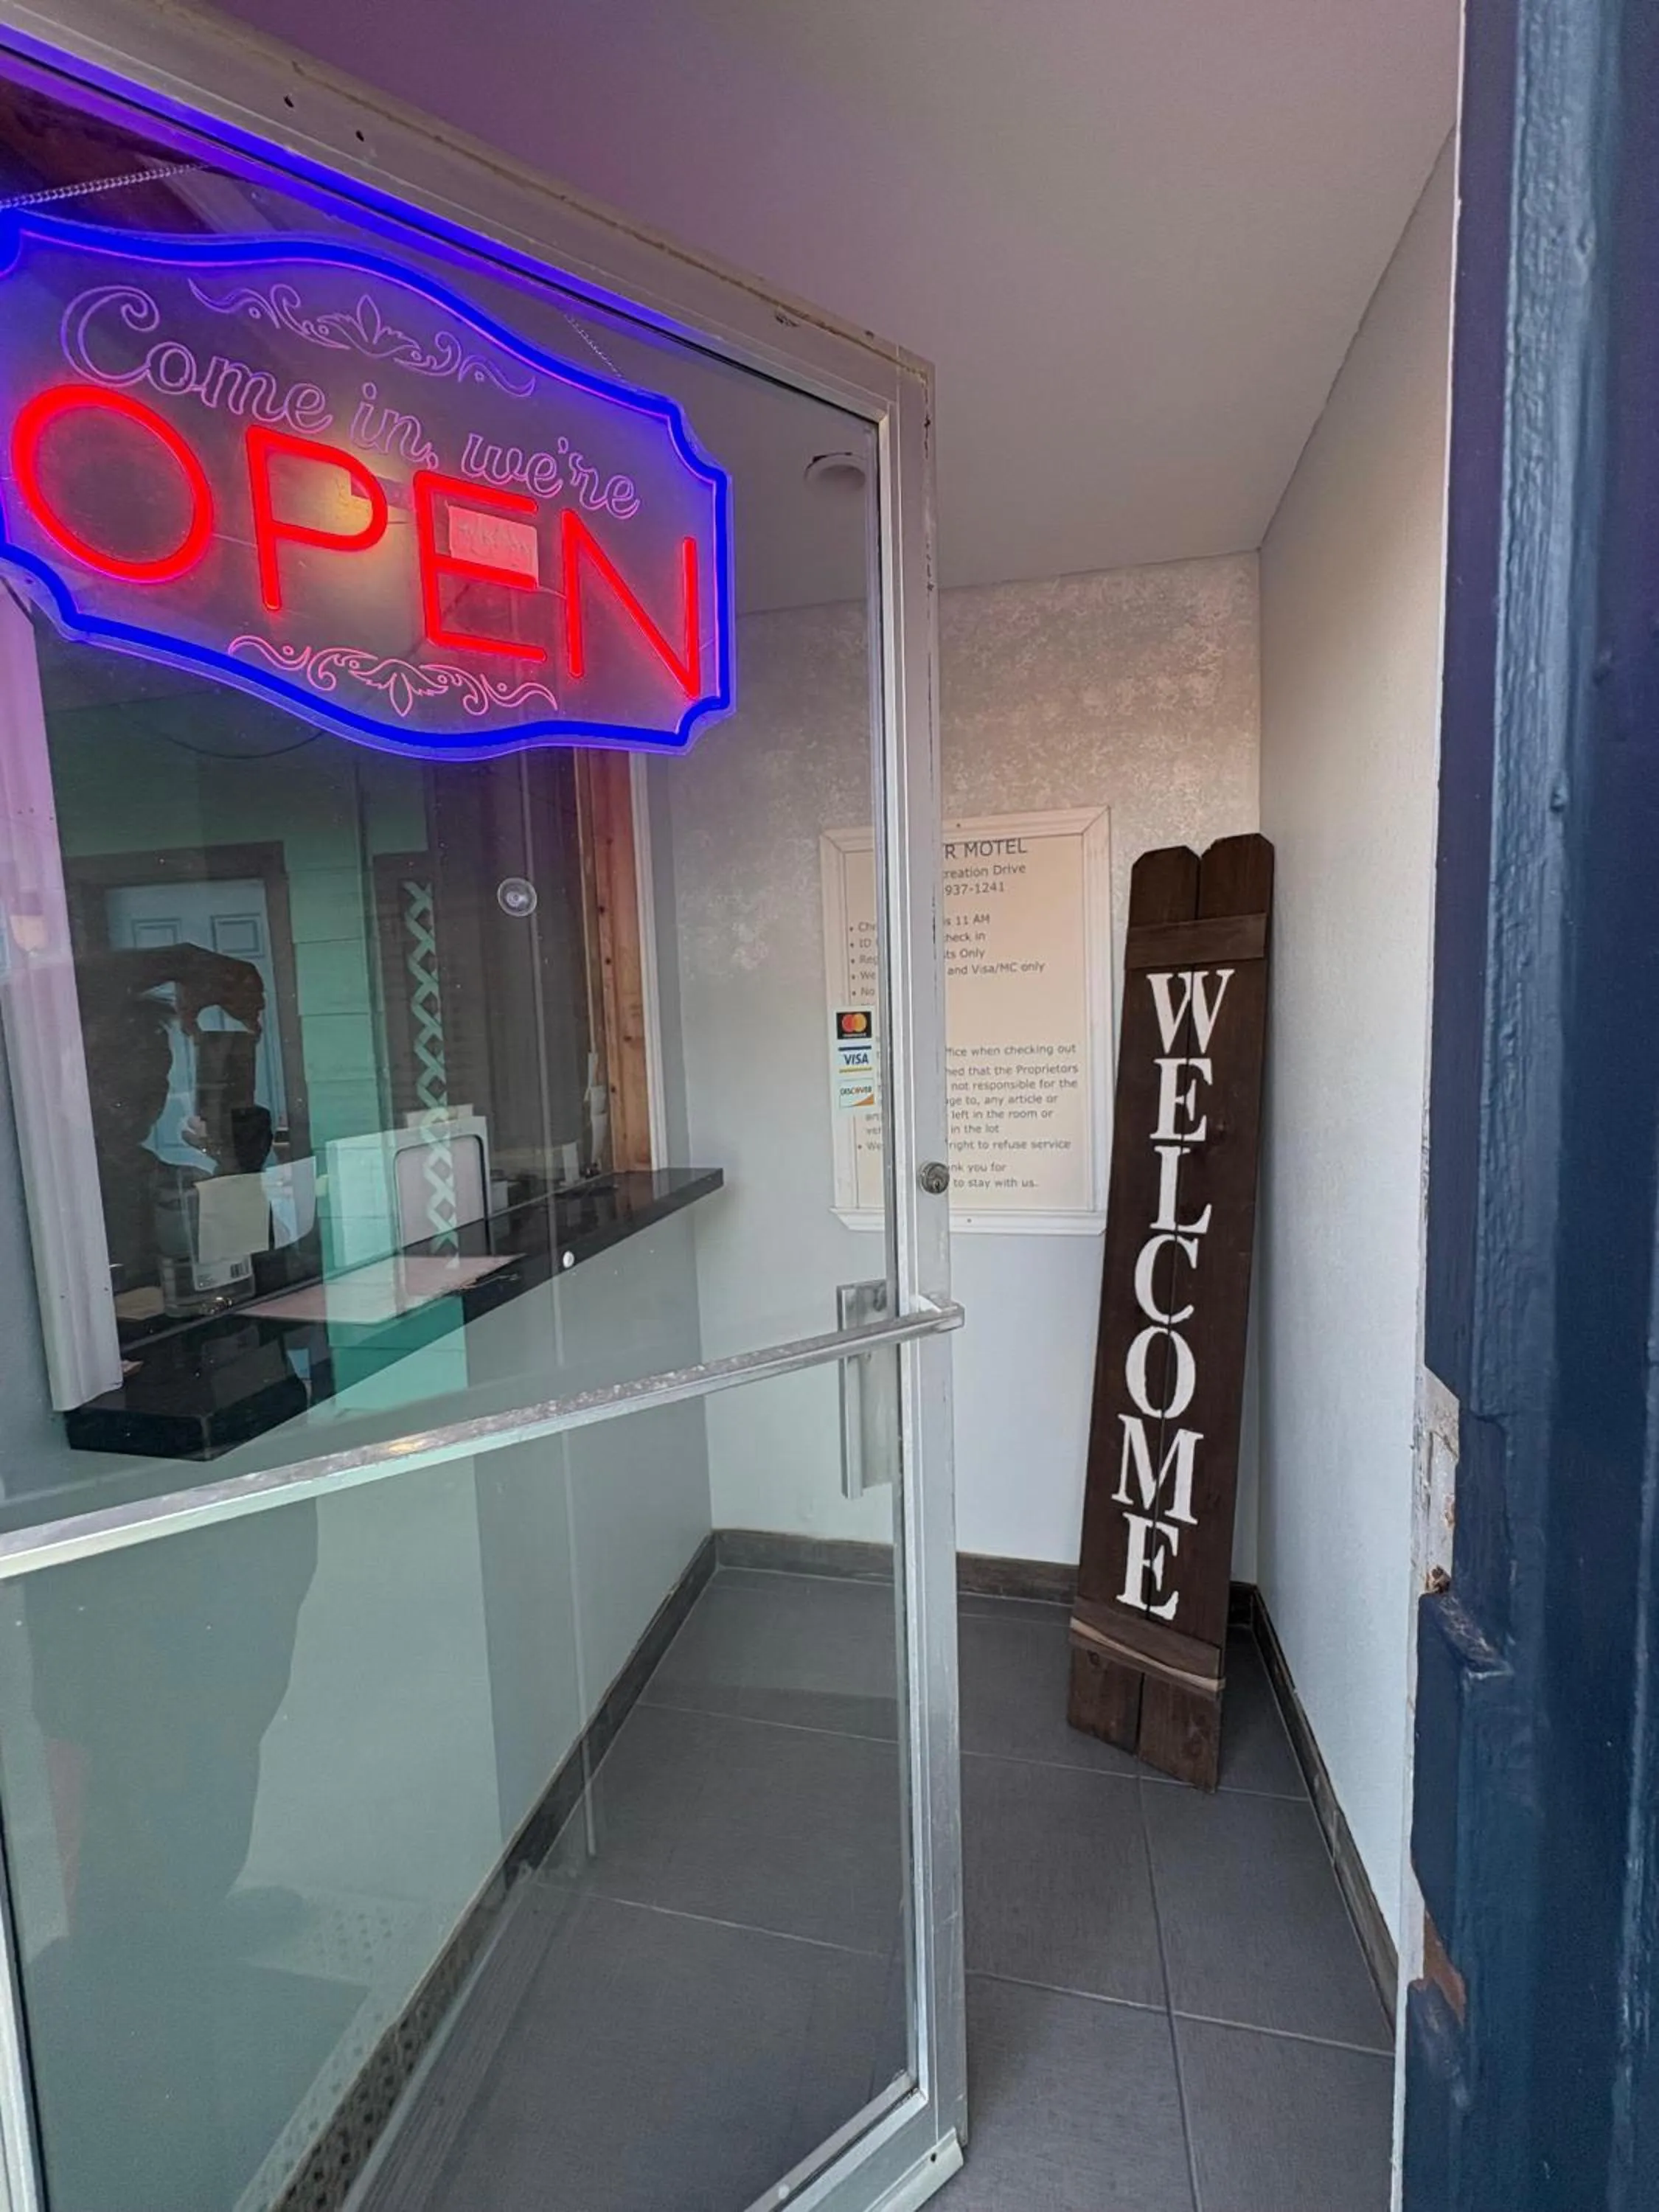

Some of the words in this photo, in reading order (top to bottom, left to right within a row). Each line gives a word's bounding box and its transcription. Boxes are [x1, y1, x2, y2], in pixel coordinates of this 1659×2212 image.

[62, 285, 333, 434] Come
[350, 383, 439, 470] in,
[461, 437, 641, 519] we're
[12, 384, 701, 699] OPEN
[964, 838, 1028, 858] MOTEL
[944, 866, 989, 879] reation
[992, 863, 1026, 875] Drive
[956, 915, 968, 925] 11
[973, 914, 990, 925] AM
[975, 931, 986, 942] in
[959, 947, 986, 960] Only
[947, 964, 968, 975] and
[971, 961, 1018, 975] Visa/MC
[1020, 960, 1046, 974] only
[970, 1046, 1001, 1057] when
[1004, 1044, 1054, 1056] checking
[1057, 1044, 1077, 1054] out
[844, 1052, 869, 1065] VISA
[968, 1065, 991, 1076] that
[994, 1065, 1013, 1075] the
[1015, 1063, 1079, 1075] Proprietors
[951, 1082, 969, 1091] not
[972, 1079, 1036, 1091] responsible
[1040, 1079, 1056, 1089] for
[1060, 1079, 1078, 1089] the
[965, 1095, 981, 1105] to,
[984, 1096, 1004, 1107] any
[1008, 1094, 1043, 1105] article
[1046, 1095, 1058, 1104] or
[951, 1110, 969, 1120] left
[973, 1110, 983, 1119] in
[987, 1109, 1004, 1119] the
[1007, 1110, 1037, 1119] room
[1040, 1110, 1053, 1119] or
[950, 1125, 961, 1134] in
[964, 1124, 982, 1134] the
[985, 1124, 1000, 1134] lot
[949, 1140, 975, 1152] right
[978, 1140, 990, 1150] to
[992, 1139, 1027, 1150] refuse
[1031, 1139, 1071, 1150] service
[967, 1164, 987, 1174] you
[991, 1162, 1007, 1172] for
[953, 1178, 965, 1188] to
[968, 1178, 991, 1189] stay
[995, 1178, 1018, 1188] with
[1021, 1178, 1040, 1188] us.
[1111, 968, 1236, 1620] WELCOME
